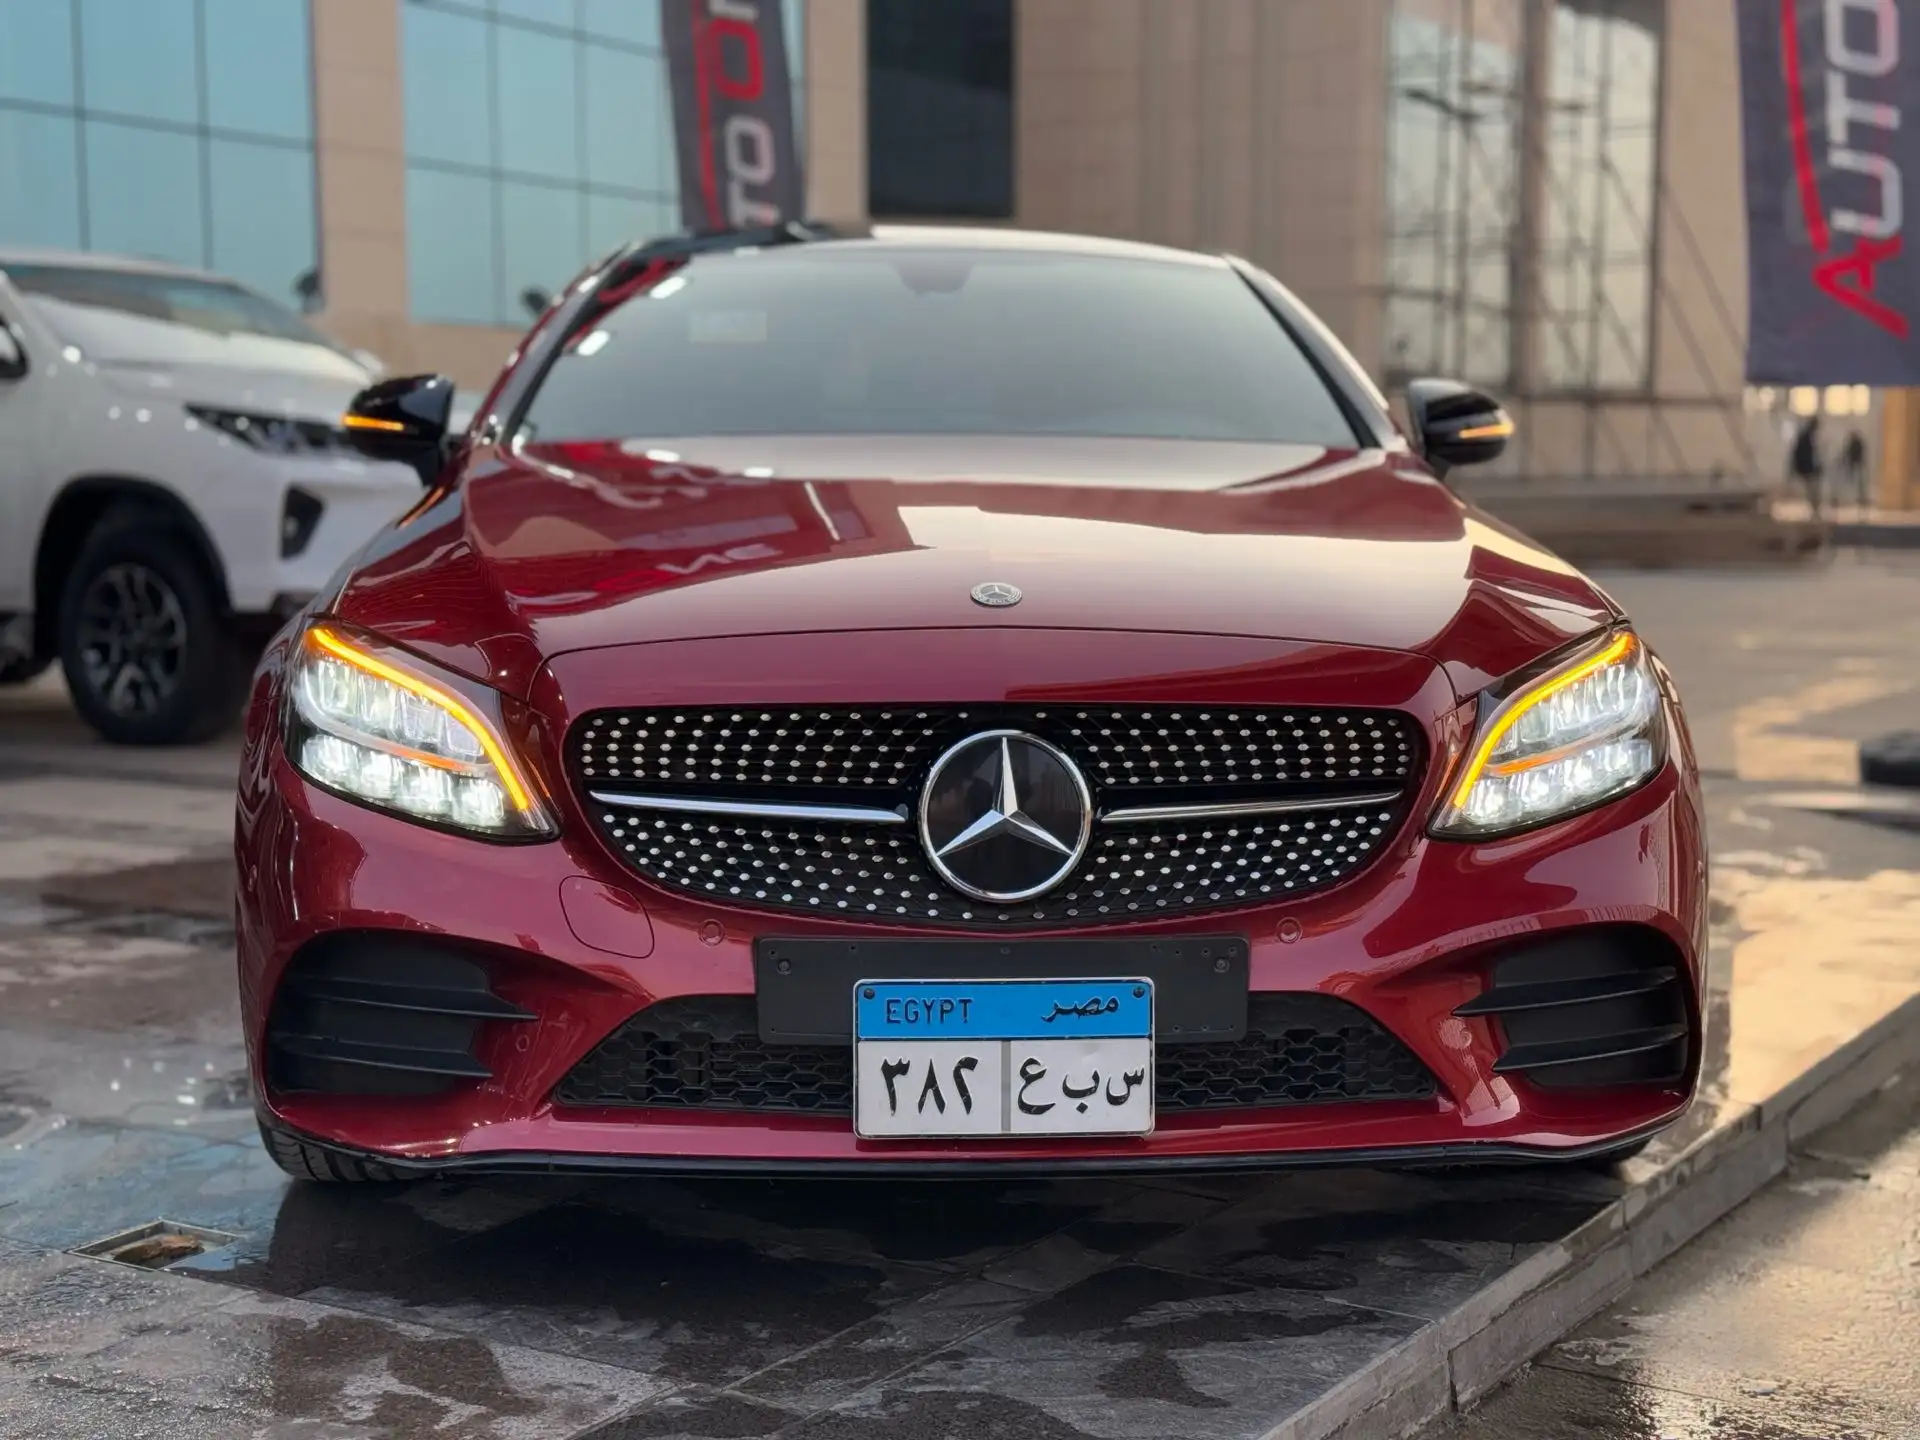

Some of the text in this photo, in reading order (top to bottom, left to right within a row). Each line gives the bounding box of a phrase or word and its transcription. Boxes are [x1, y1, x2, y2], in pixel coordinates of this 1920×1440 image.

[1811, 0, 1910, 340] AUTO
[886, 997, 973, 1025] EGYPT
[1040, 995, 1120, 1023] مصر
[880, 1055, 979, 1116] ٣٨٢
